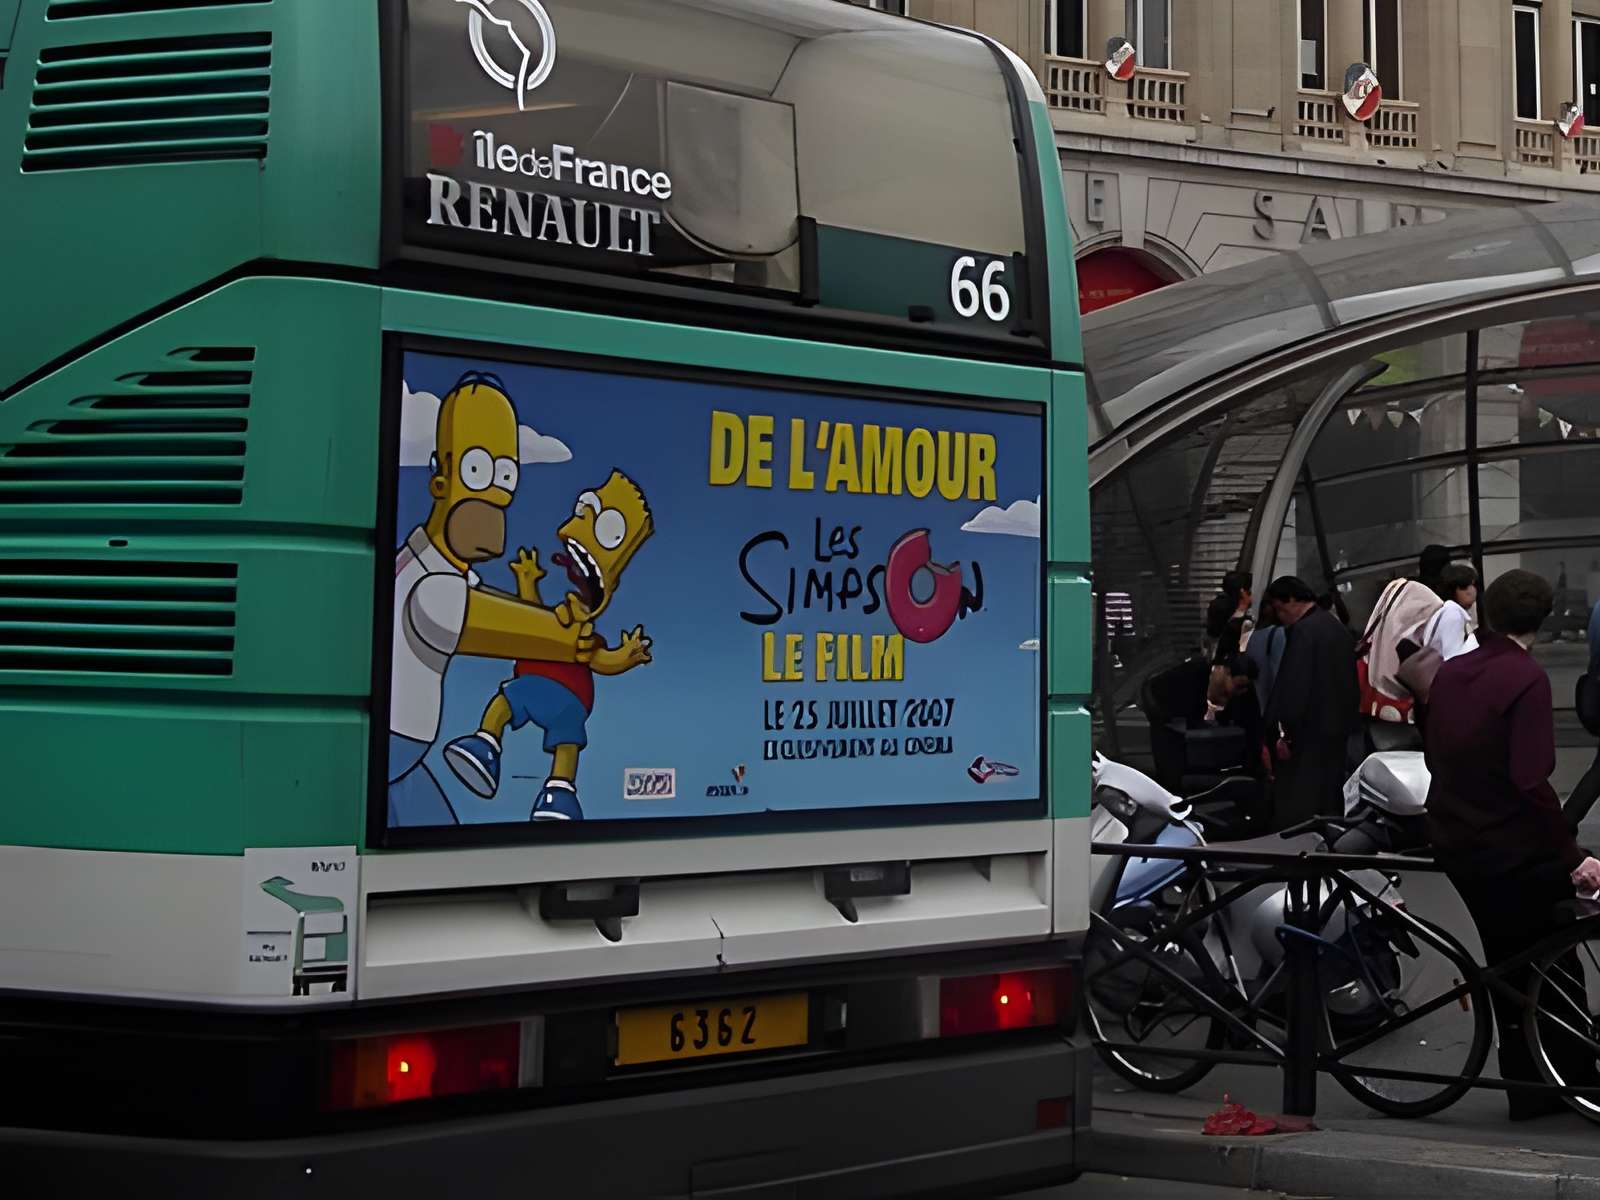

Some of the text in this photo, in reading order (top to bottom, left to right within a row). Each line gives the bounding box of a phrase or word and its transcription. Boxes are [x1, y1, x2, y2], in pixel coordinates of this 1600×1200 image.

[426, 172, 661, 257] RENAULT
[950, 255, 1011, 322] 66
[708, 409, 998, 501] DE L'AMOUR
[761, 630, 906, 682] LE FILM
[763, 698, 785, 731] LE
[791, 699, 819, 731] 25
[826, 698, 898, 730] JUILLET
[669, 1006, 757, 1053] 6362
